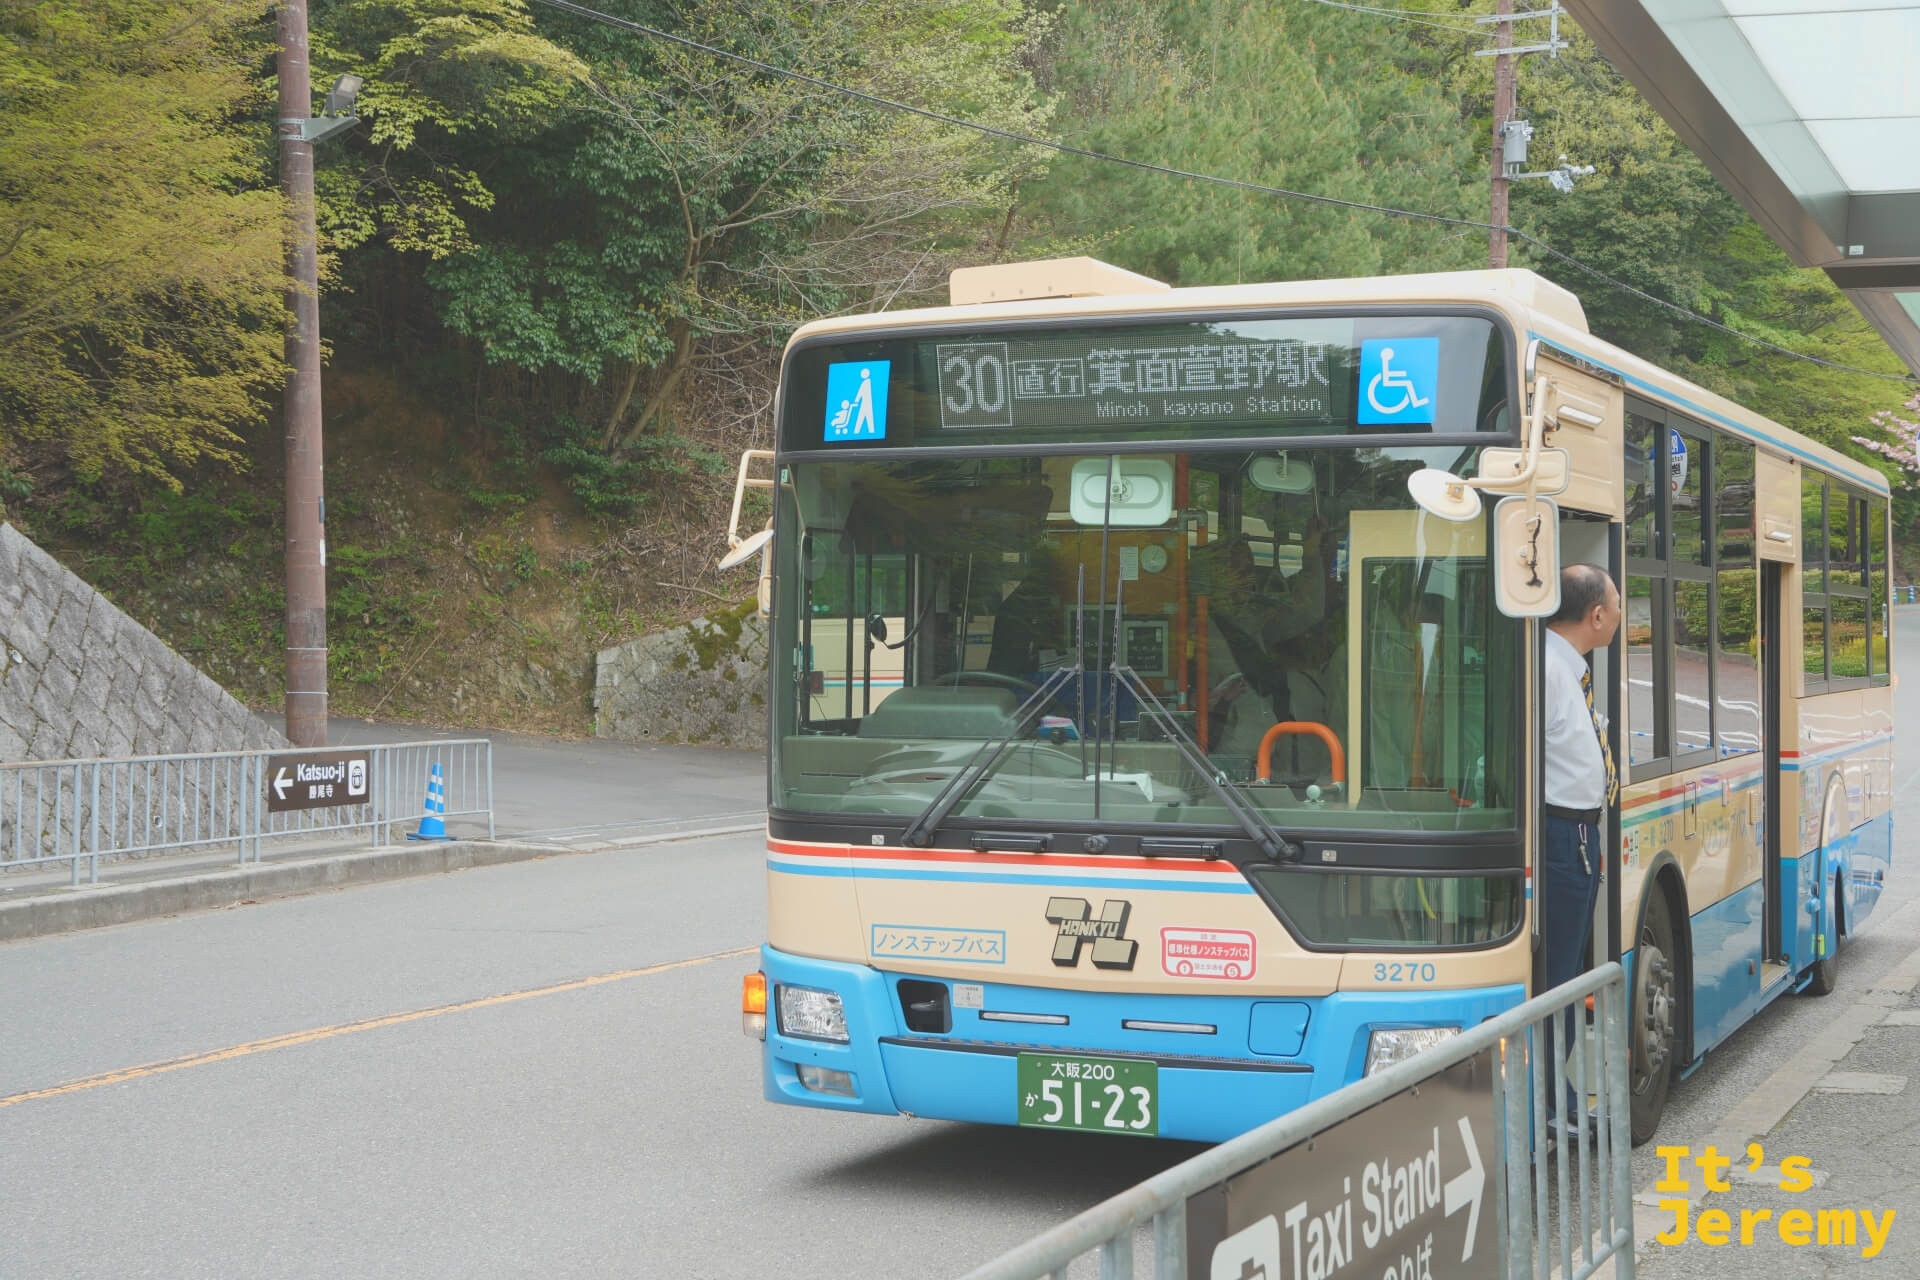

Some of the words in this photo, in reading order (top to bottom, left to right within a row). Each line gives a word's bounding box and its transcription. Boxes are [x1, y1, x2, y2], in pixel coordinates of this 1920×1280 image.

[943, 355, 1005, 413] 30
[1017, 362, 1081, 396] 直行
[1097, 400, 1149, 418] Minoh
[1163, 399, 1234, 416] kayano
[1247, 395, 1321, 414] Station
[297, 760, 345, 784] Katsuo-ji
[1059, 918, 1121, 938] HANKYU
[876, 932, 1001, 956] ノンステップバス
[1374, 962, 1436, 982] 3270
[1041, 1079, 1152, 1130] 51-23
[1284, 1175, 1353, 1280] Taxi
[1361, 1125, 1441, 1249] Stand
